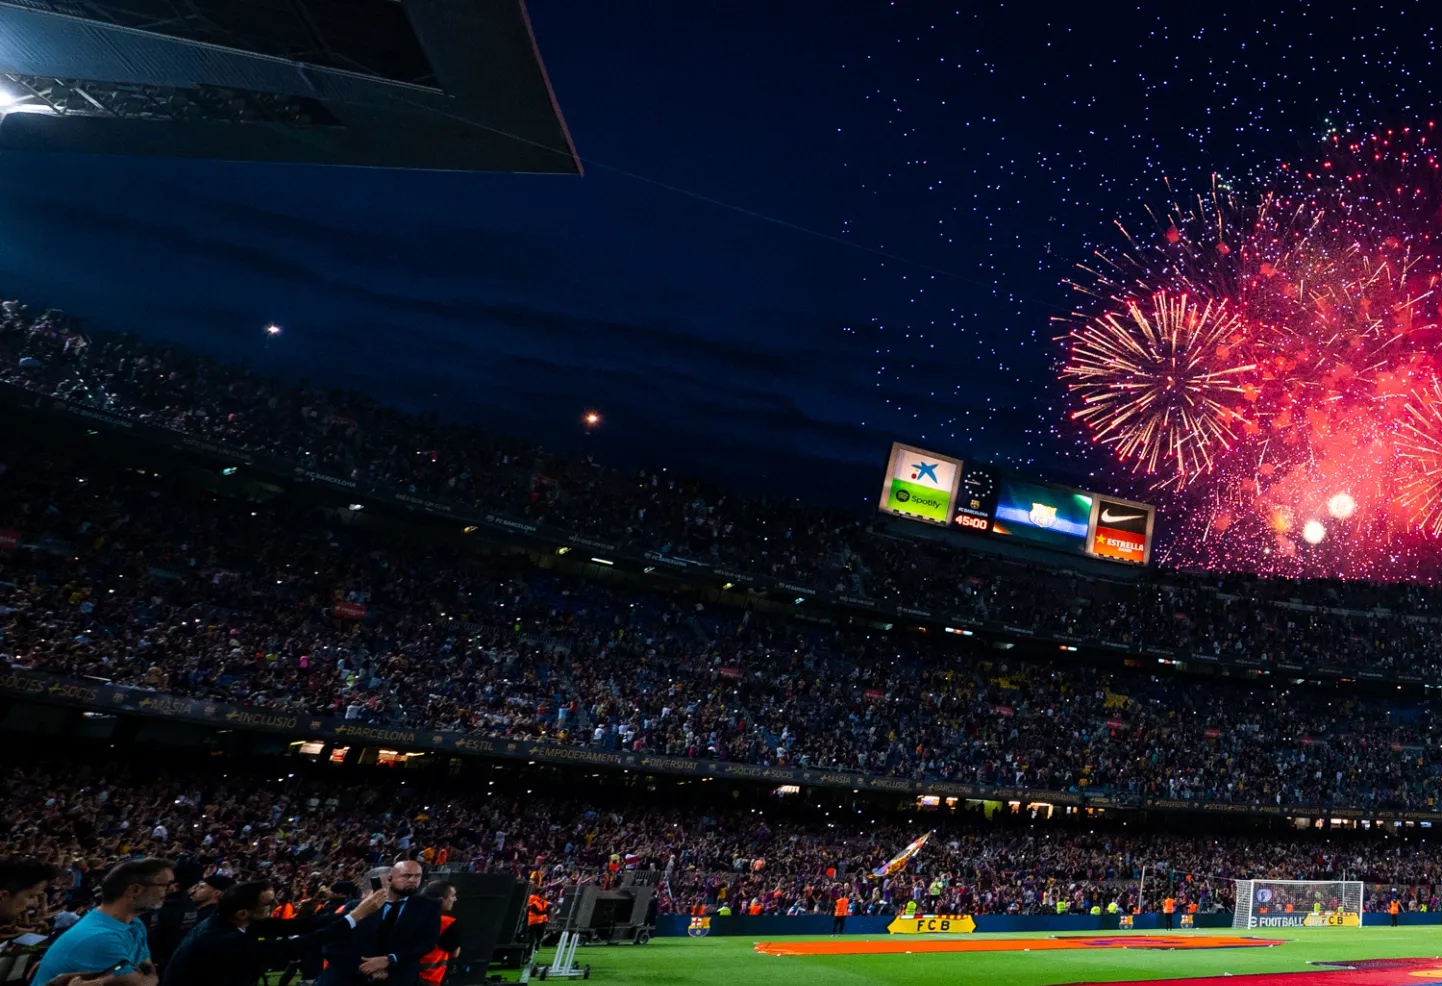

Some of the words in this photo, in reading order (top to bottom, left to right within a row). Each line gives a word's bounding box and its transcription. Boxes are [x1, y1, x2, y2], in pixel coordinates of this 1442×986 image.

[911, 495, 942, 509] Spotify
[955, 515, 987, 530] 45:00
[1107, 538, 1144, 551] ESTRELLA
[917, 920, 950, 932] FCB
